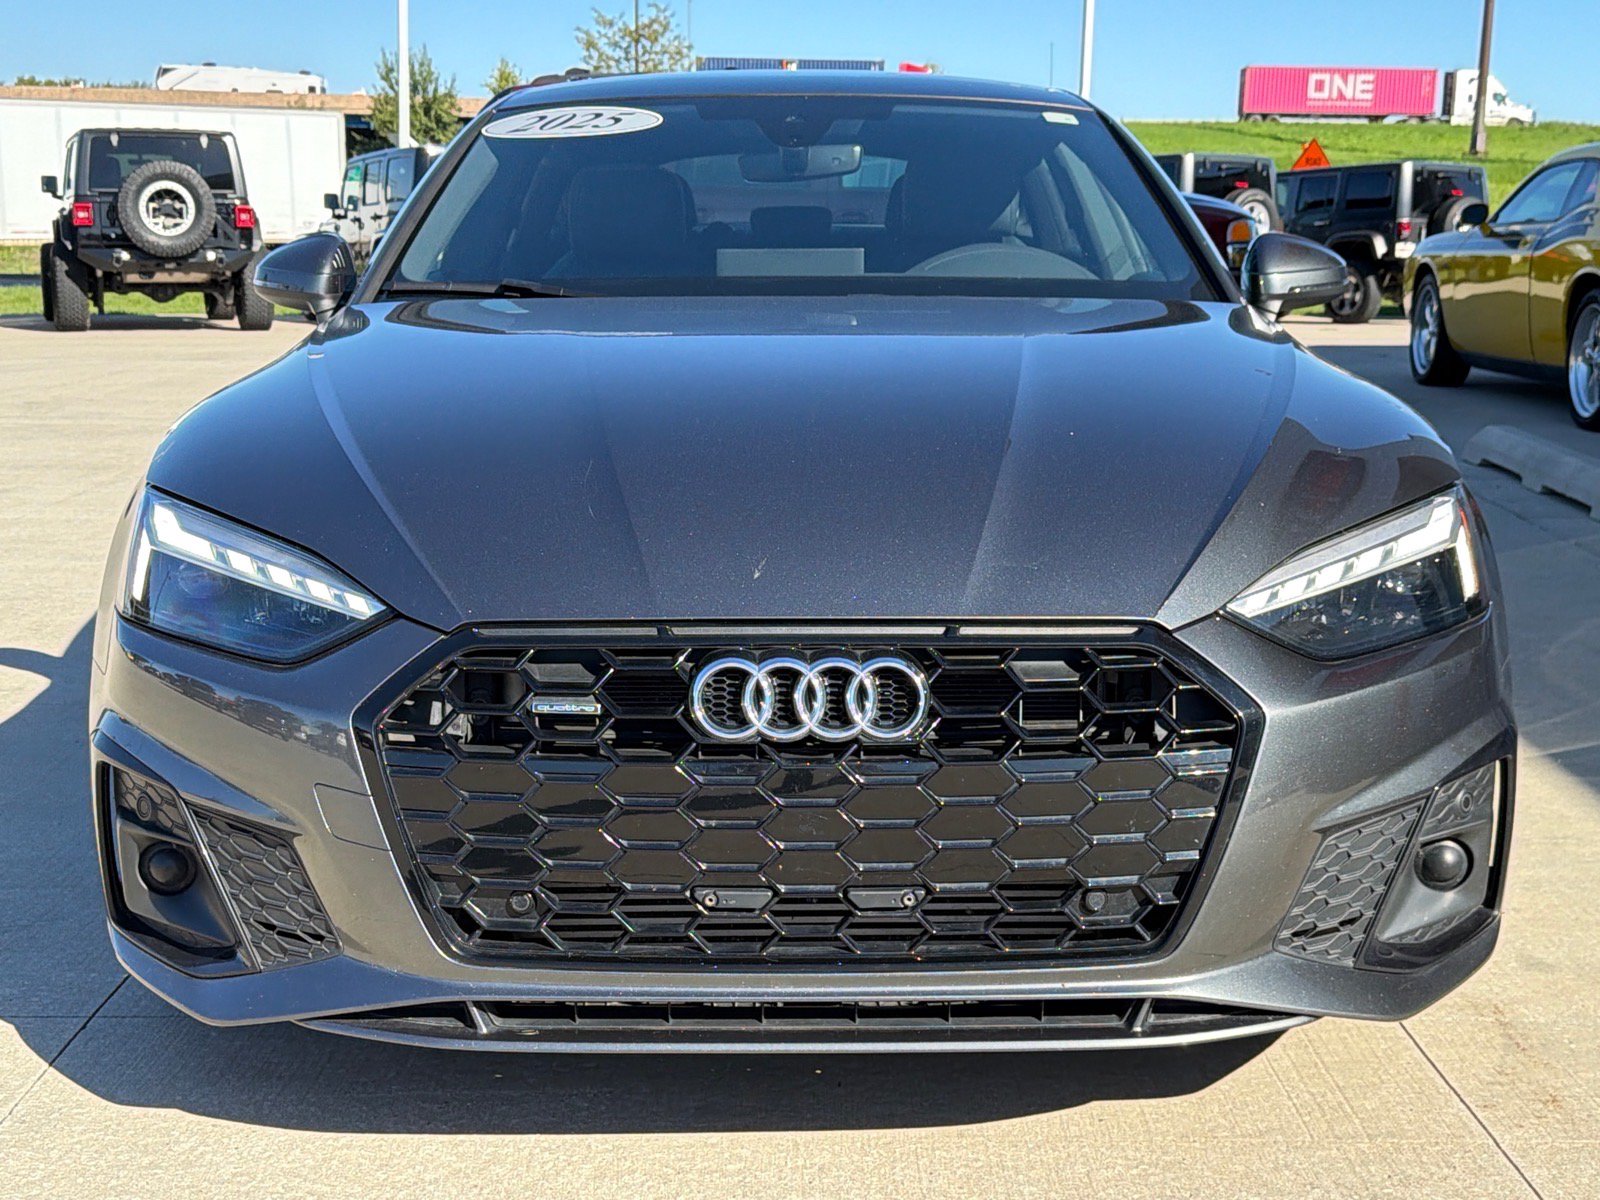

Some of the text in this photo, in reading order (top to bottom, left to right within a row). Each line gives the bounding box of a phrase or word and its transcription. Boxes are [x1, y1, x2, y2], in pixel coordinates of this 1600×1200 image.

[1307, 73, 1375, 100] ONE
[506, 112, 635, 133] 2025
[537, 703, 595, 712] quattro
